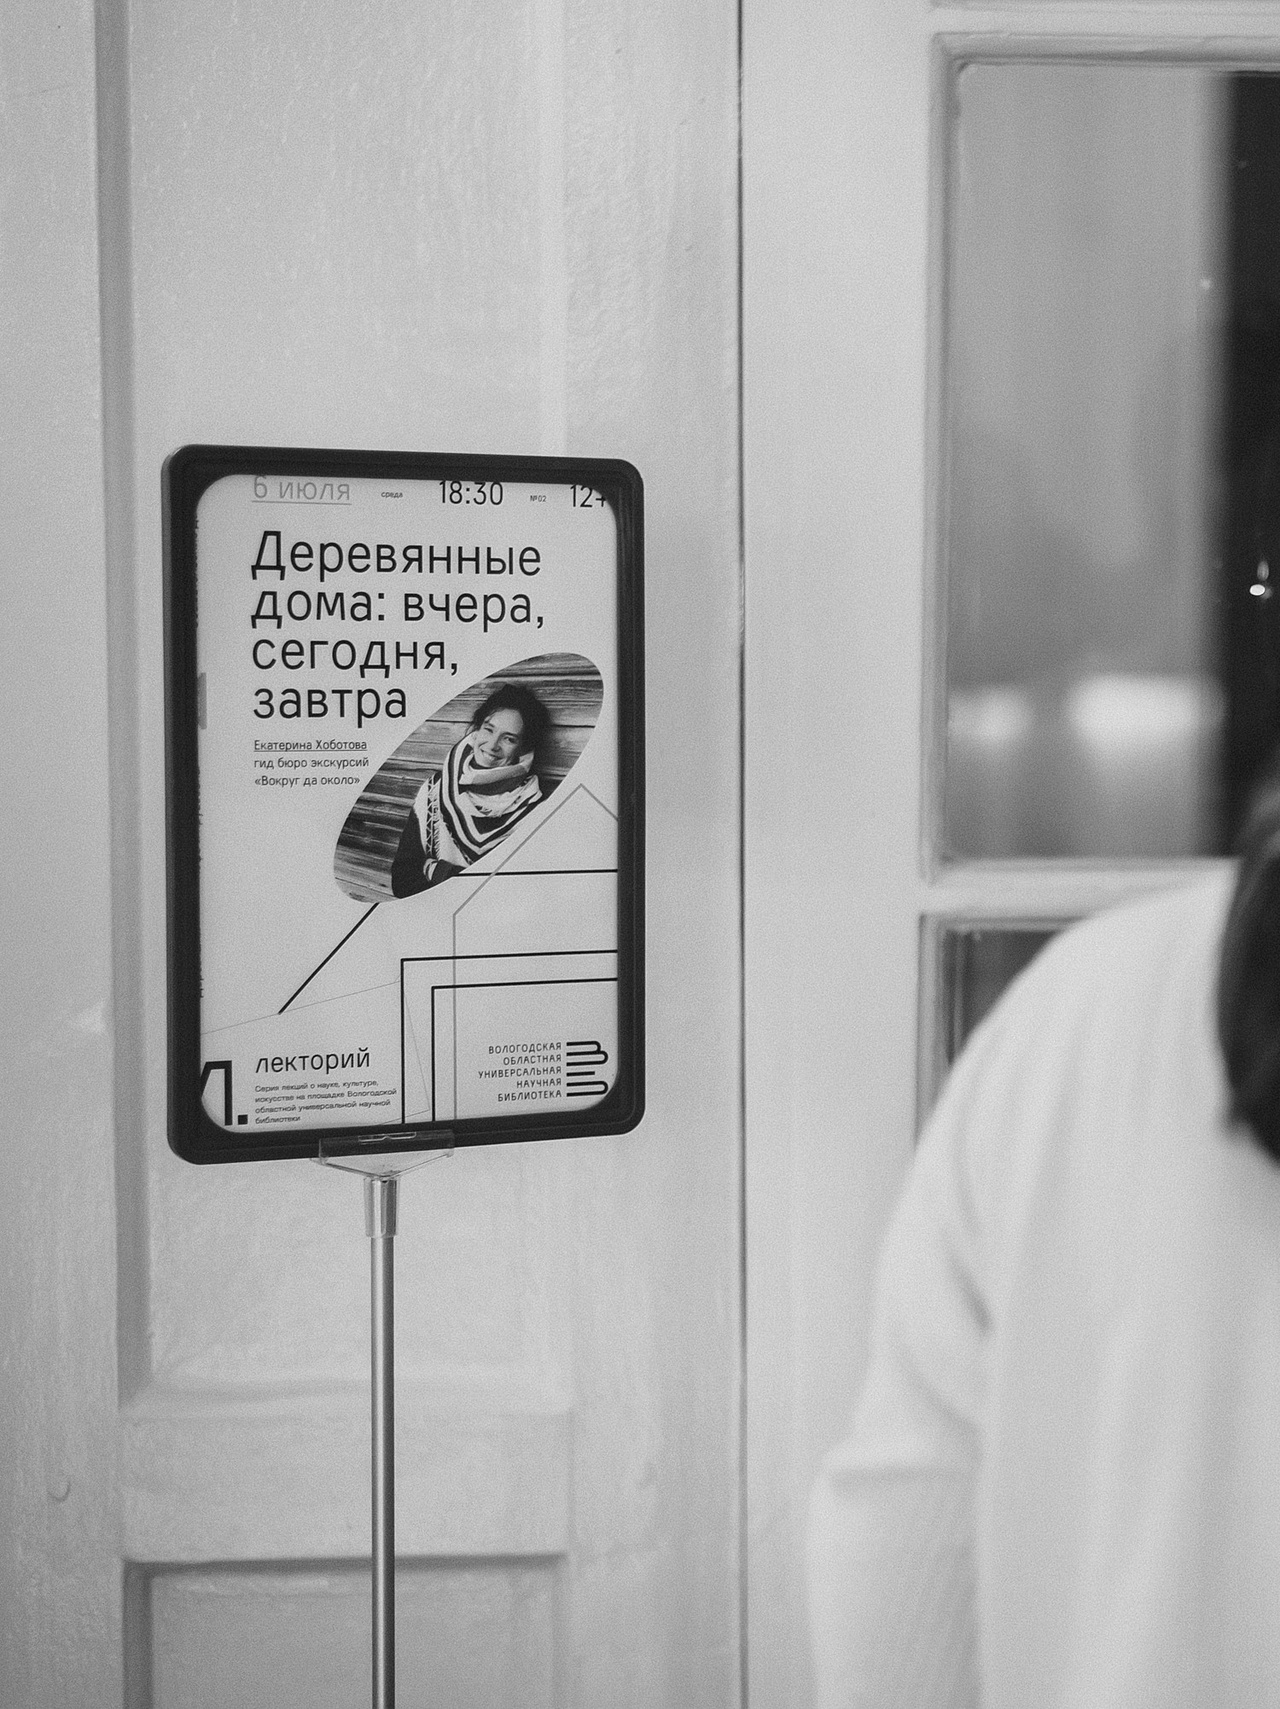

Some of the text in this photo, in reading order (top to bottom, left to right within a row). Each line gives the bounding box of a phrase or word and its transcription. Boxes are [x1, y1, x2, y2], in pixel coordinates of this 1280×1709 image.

[253, 475, 350, 500] 6 июля
[381, 490, 403, 499] среда
[439, 480, 504, 506] 18:30
[570, 484, 607, 508] 12+
[251, 530, 541, 583] Деревянные
[251, 590, 544, 633] дома: вчера,
[252, 638, 458, 679] сегодня,
[253, 687, 407, 729] завтра
[254, 738, 367, 752] Екатерина Хоботова
[253, 756, 369, 769] гид бюро экскурсий
[254, 774, 361, 788] «Вокруг да около»
[488, 1042, 562, 1054] ВОЛОГОДСКАЯ
[255, 1046, 370, 1075] лекторий
[504, 1054, 562, 1065] ОБЛАСТНАЯ
[478, 1066, 562, 1078] УНИВЕРСАЛЬНАЯ
[255, 1084, 280, 1094] Серия
[281, 1082, 309, 1091] лекций
[317, 1081, 341, 1090] науке,
[342, 1079, 379, 1089] культуре,
[517, 1078, 562, 1088] НАУЧНАЯ
[254, 1094, 295, 1104] искусстве
[307, 1092, 345, 1100] площадке
[347, 1087, 398, 1098] Вологодской
[498, 1090, 562, 1101] БИБЛИОТЕКА
[254, 1098, 392, 1114] областной универсальной научной
[254, 1115, 301, 1125] библиотеки
